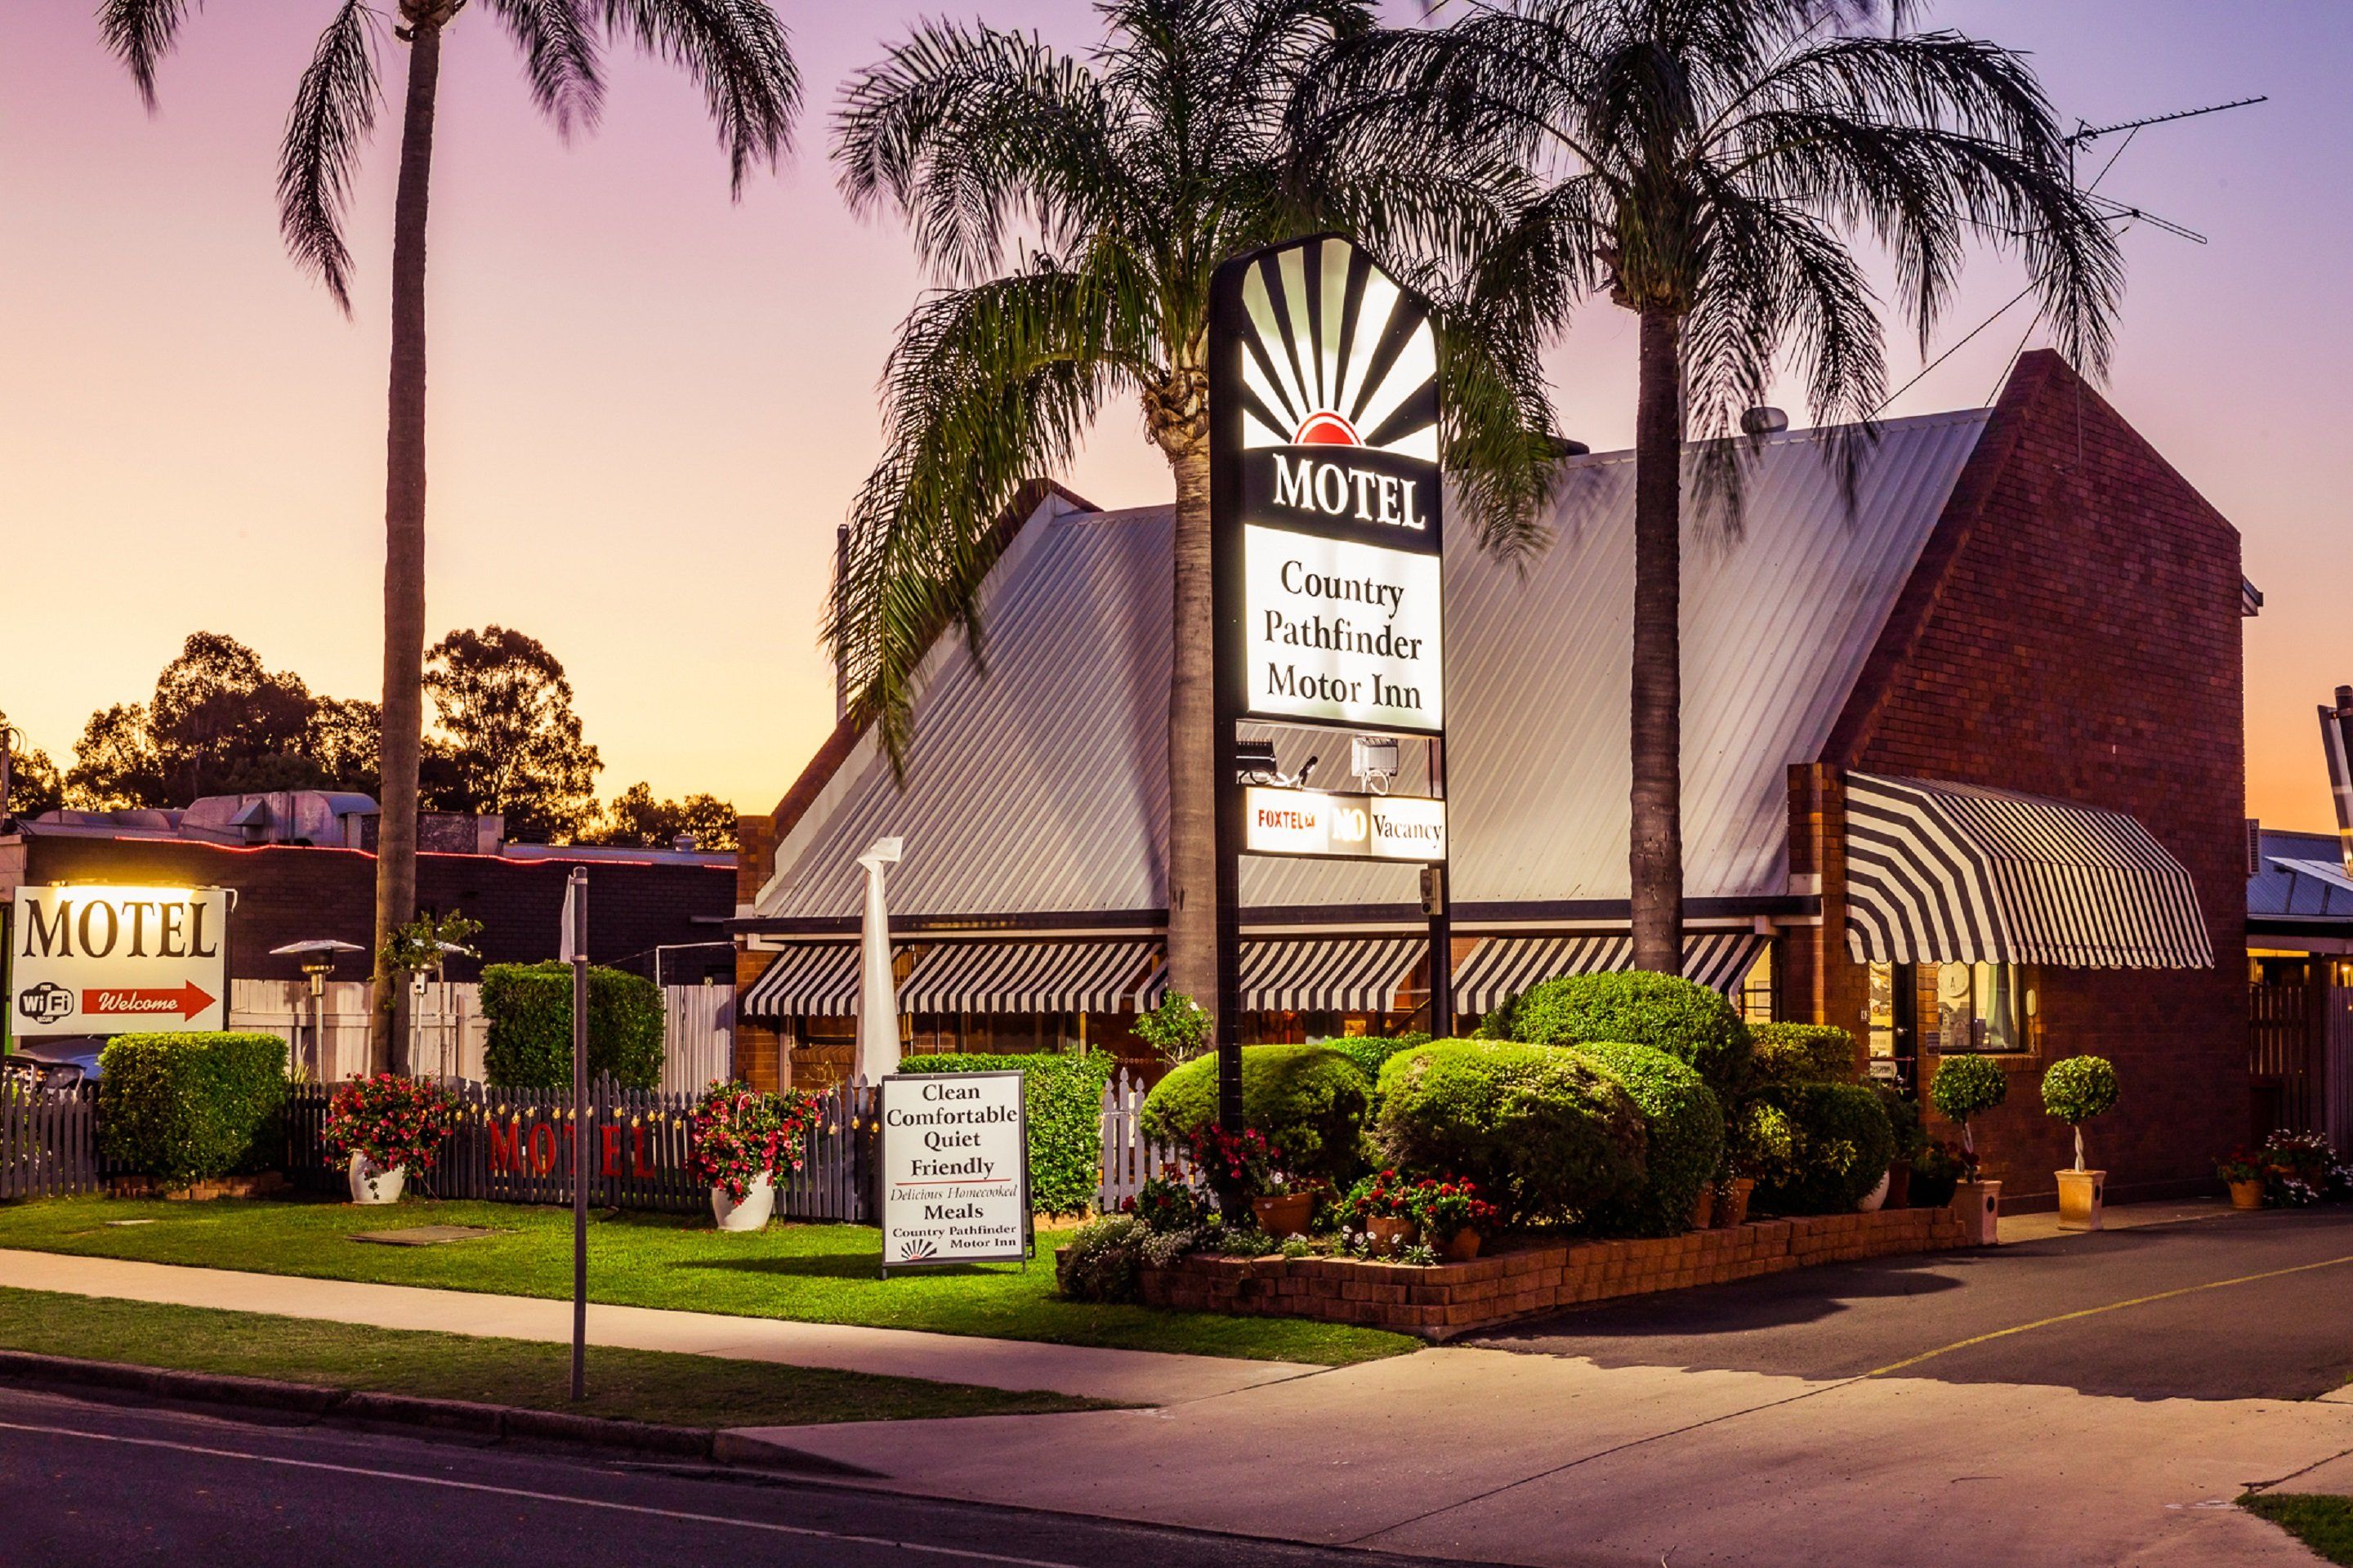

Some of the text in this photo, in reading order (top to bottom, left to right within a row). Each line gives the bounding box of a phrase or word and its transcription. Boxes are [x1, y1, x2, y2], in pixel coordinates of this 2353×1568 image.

[1273, 453, 1426, 530] MOTEL
[1281, 561, 1405, 619] Country
[1264, 610, 1422, 660] Pathfinder
[1267, 661, 1422, 710] Motor Inn
[1258, 809, 1304, 829] FOXTEL
[1332, 807, 1443, 849] NO Vacancy
[21, 899, 217, 958] MOTEL
[98, 991, 178, 1011] Welcome
[922, 1084, 981, 1101] Clean
[886, 1105, 1018, 1127] Comfortable
[924, 1131, 981, 1151] Quiet
[911, 1157, 995, 1179] Friendly
[891, 1185, 1018, 1201] Delicious Homecooked
[924, 1204, 985, 1220] Meals
[893, 1226, 1016, 1239] Country Pathfinder
[950, 1238, 1016, 1249] Motor Inn
